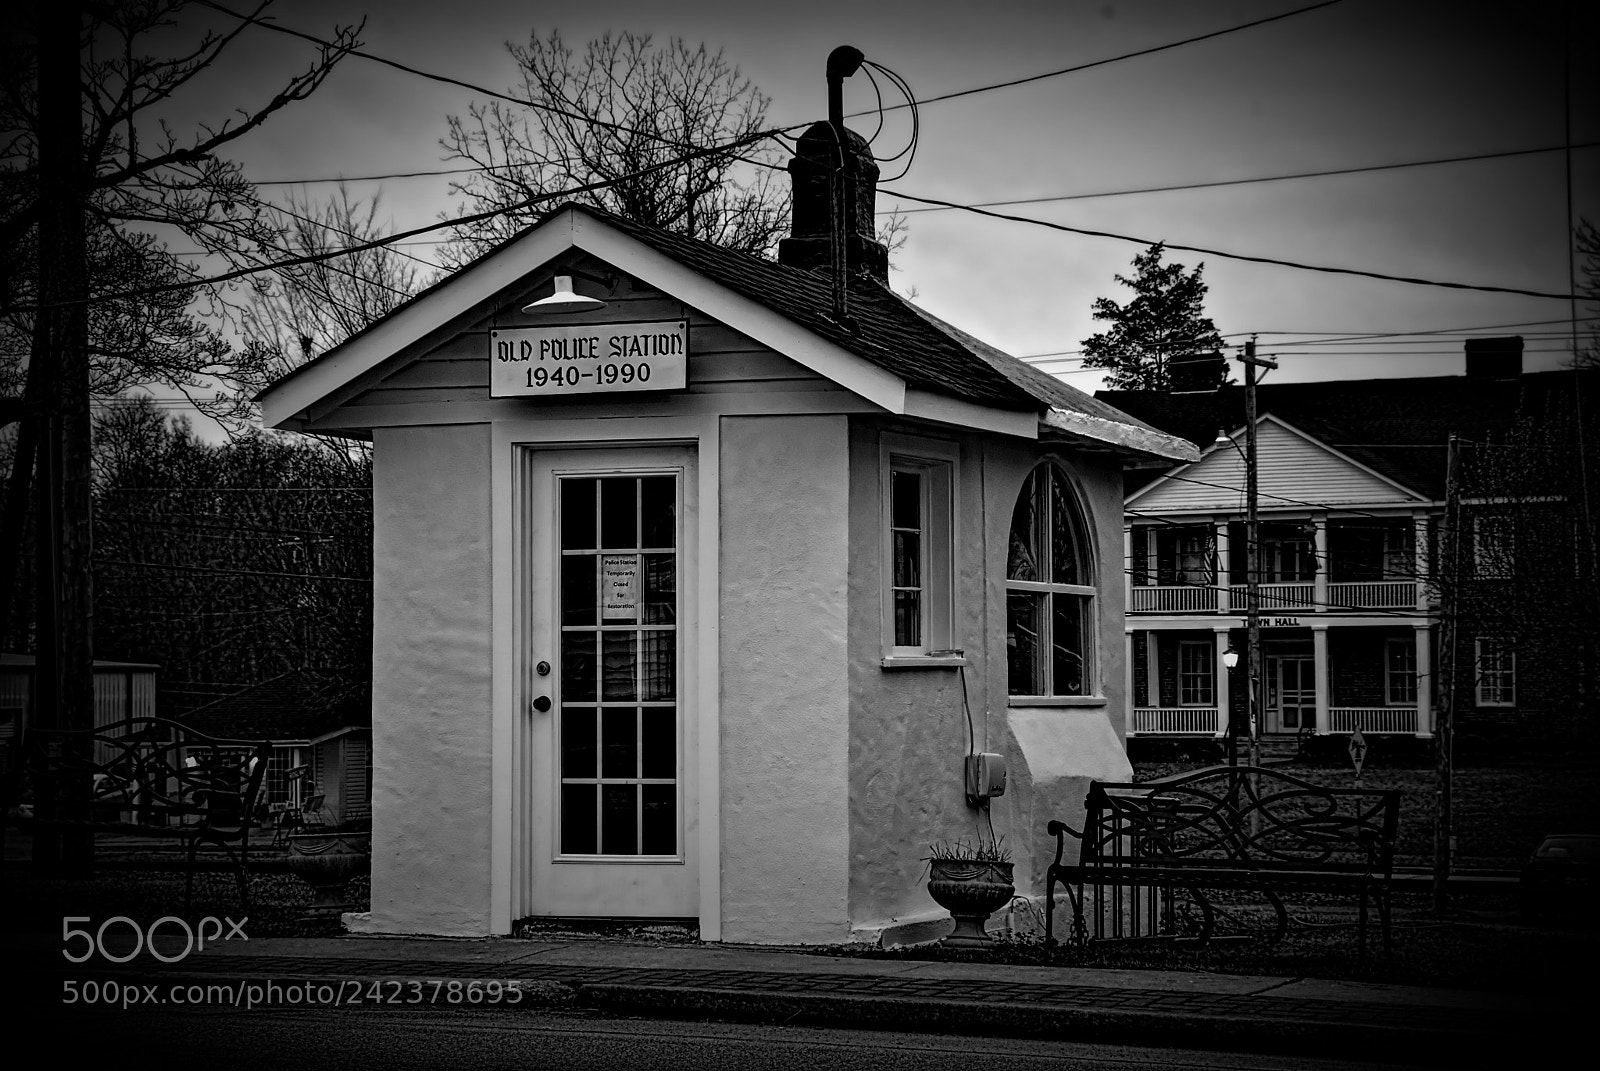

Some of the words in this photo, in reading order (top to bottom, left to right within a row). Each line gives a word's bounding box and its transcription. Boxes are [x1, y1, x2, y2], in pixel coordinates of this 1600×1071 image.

[498, 339, 532, 362] OLD
[539, 336, 600, 361] POLICE
[608, 332, 683, 358] STATION
[526, 363, 651, 387] 1940-1990
[1241, 618, 1270, 627] TWN
[1275, 617, 1300, 627] HALL
